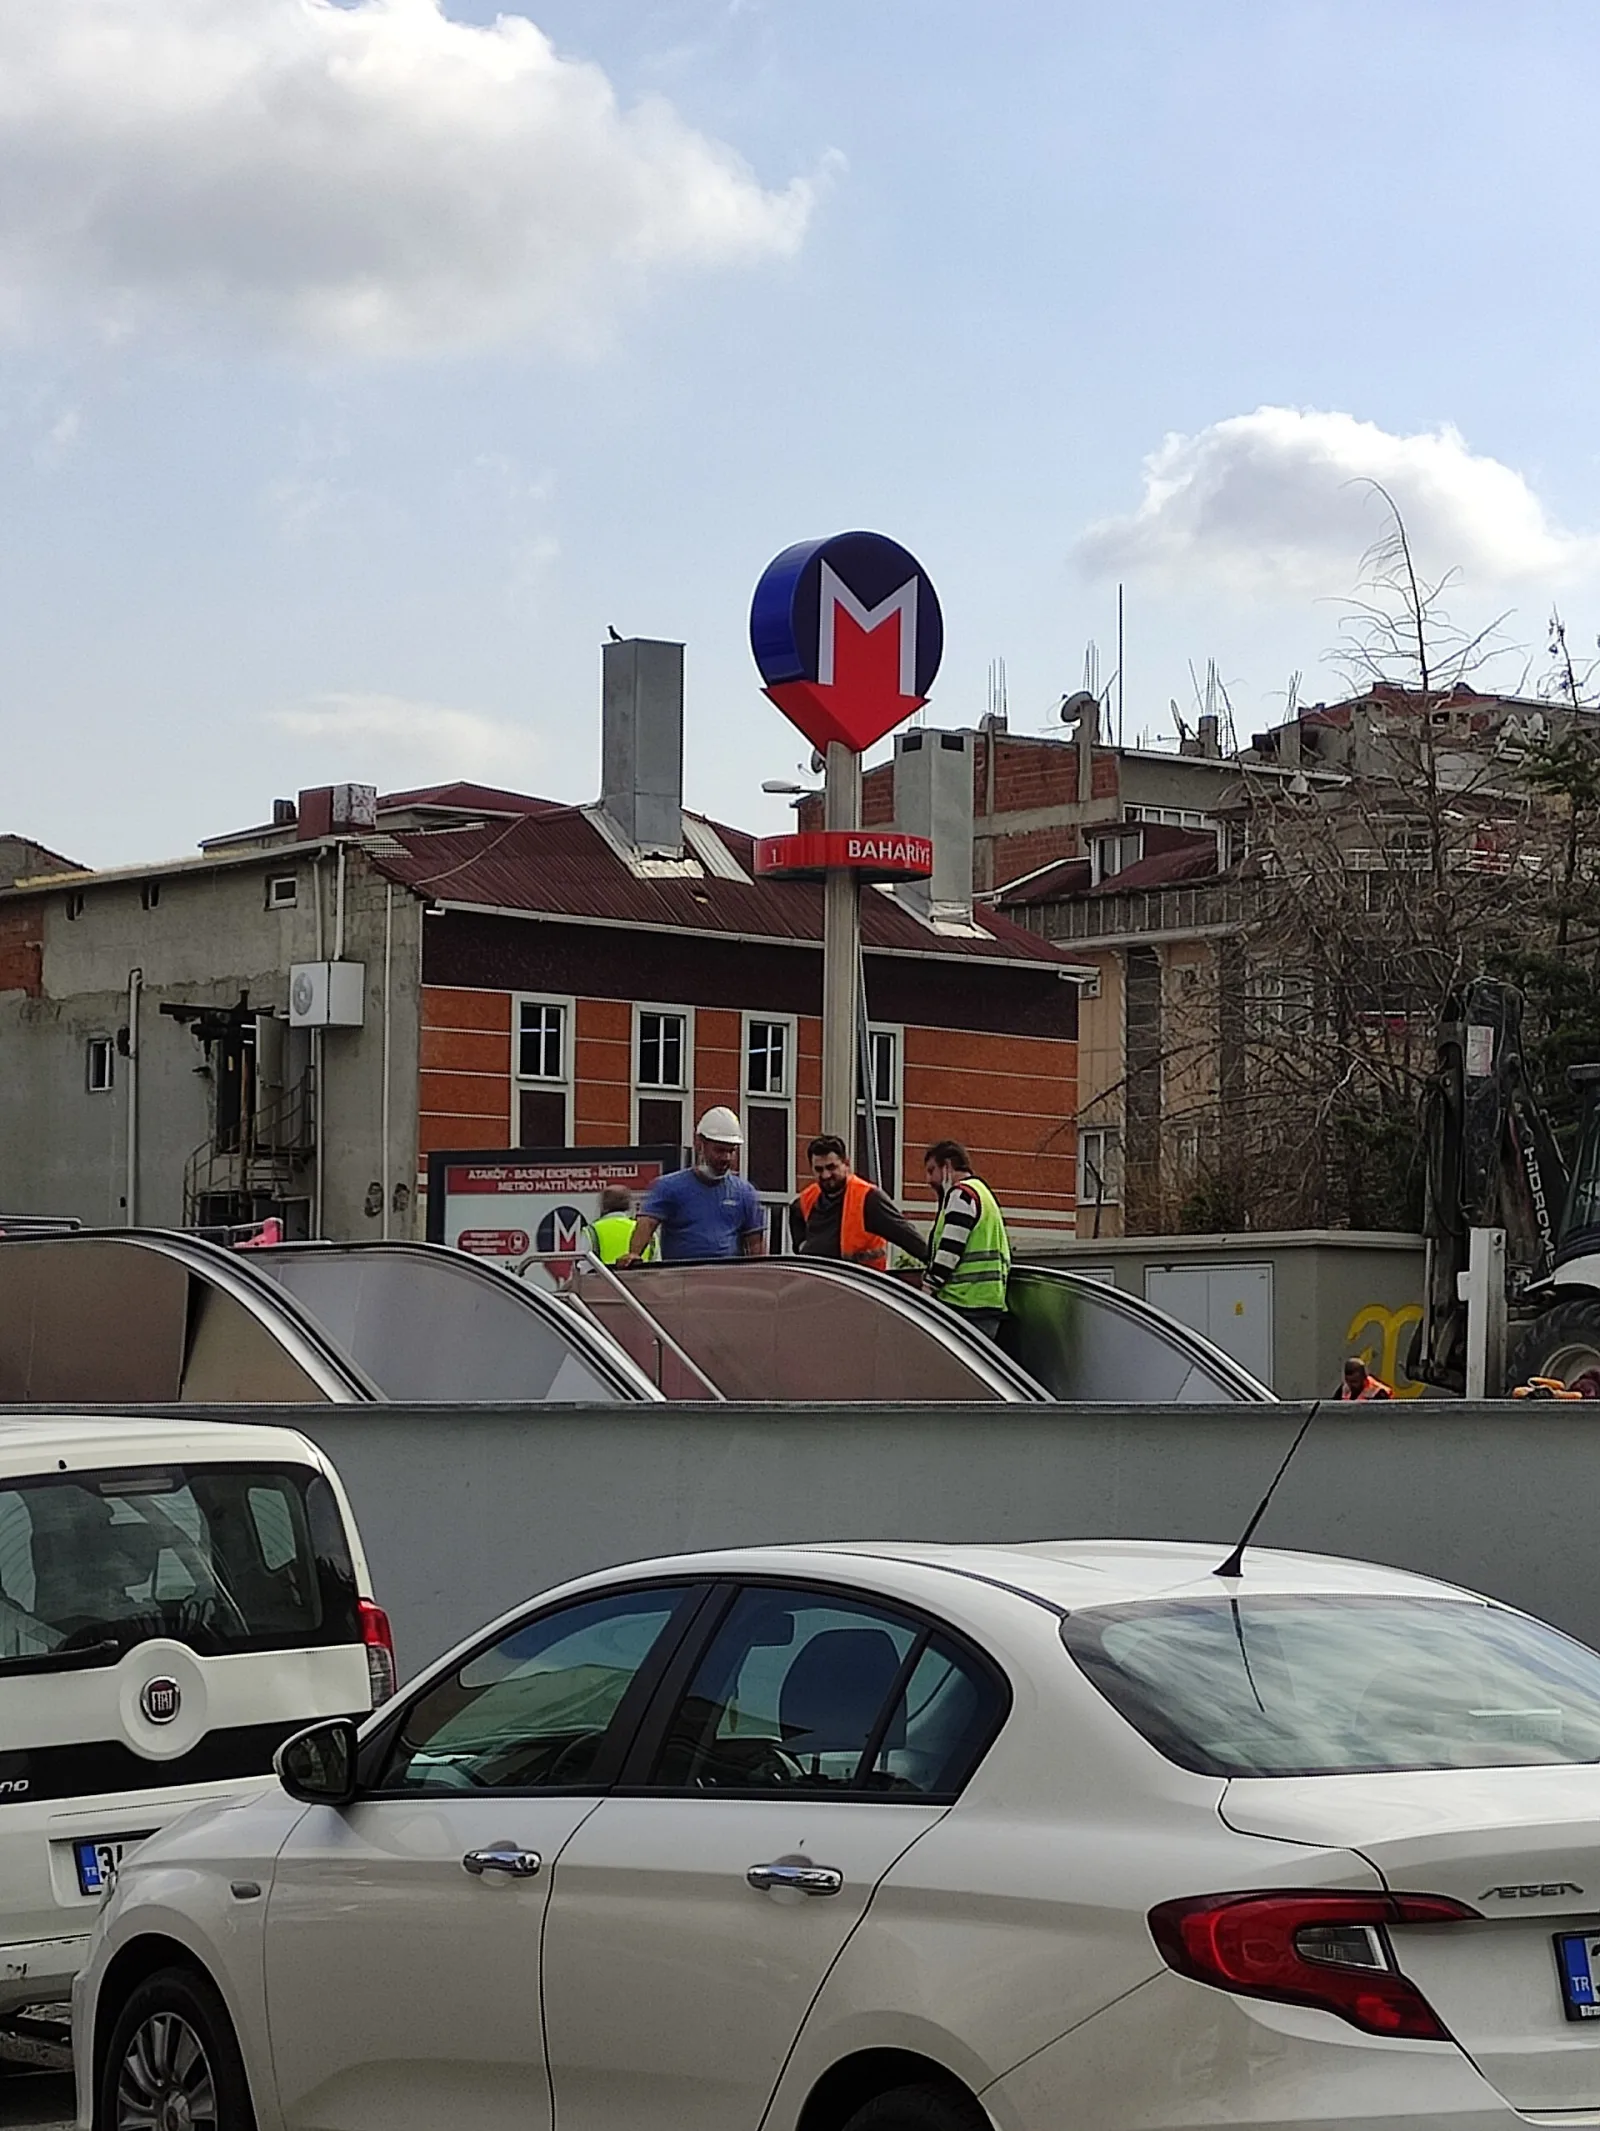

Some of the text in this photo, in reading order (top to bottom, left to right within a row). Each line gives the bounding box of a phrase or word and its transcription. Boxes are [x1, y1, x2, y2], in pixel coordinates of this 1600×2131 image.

[818, 557, 918, 697] M
[468, 1166, 507, 1180] ATAKÖY
[546, 1166, 592, 1179] EKSPRES
[498, 1180, 534, 1192] METRO
[152, 1690, 173, 1711] FIAT
[1572, 1976, 1590, 1992] TR
